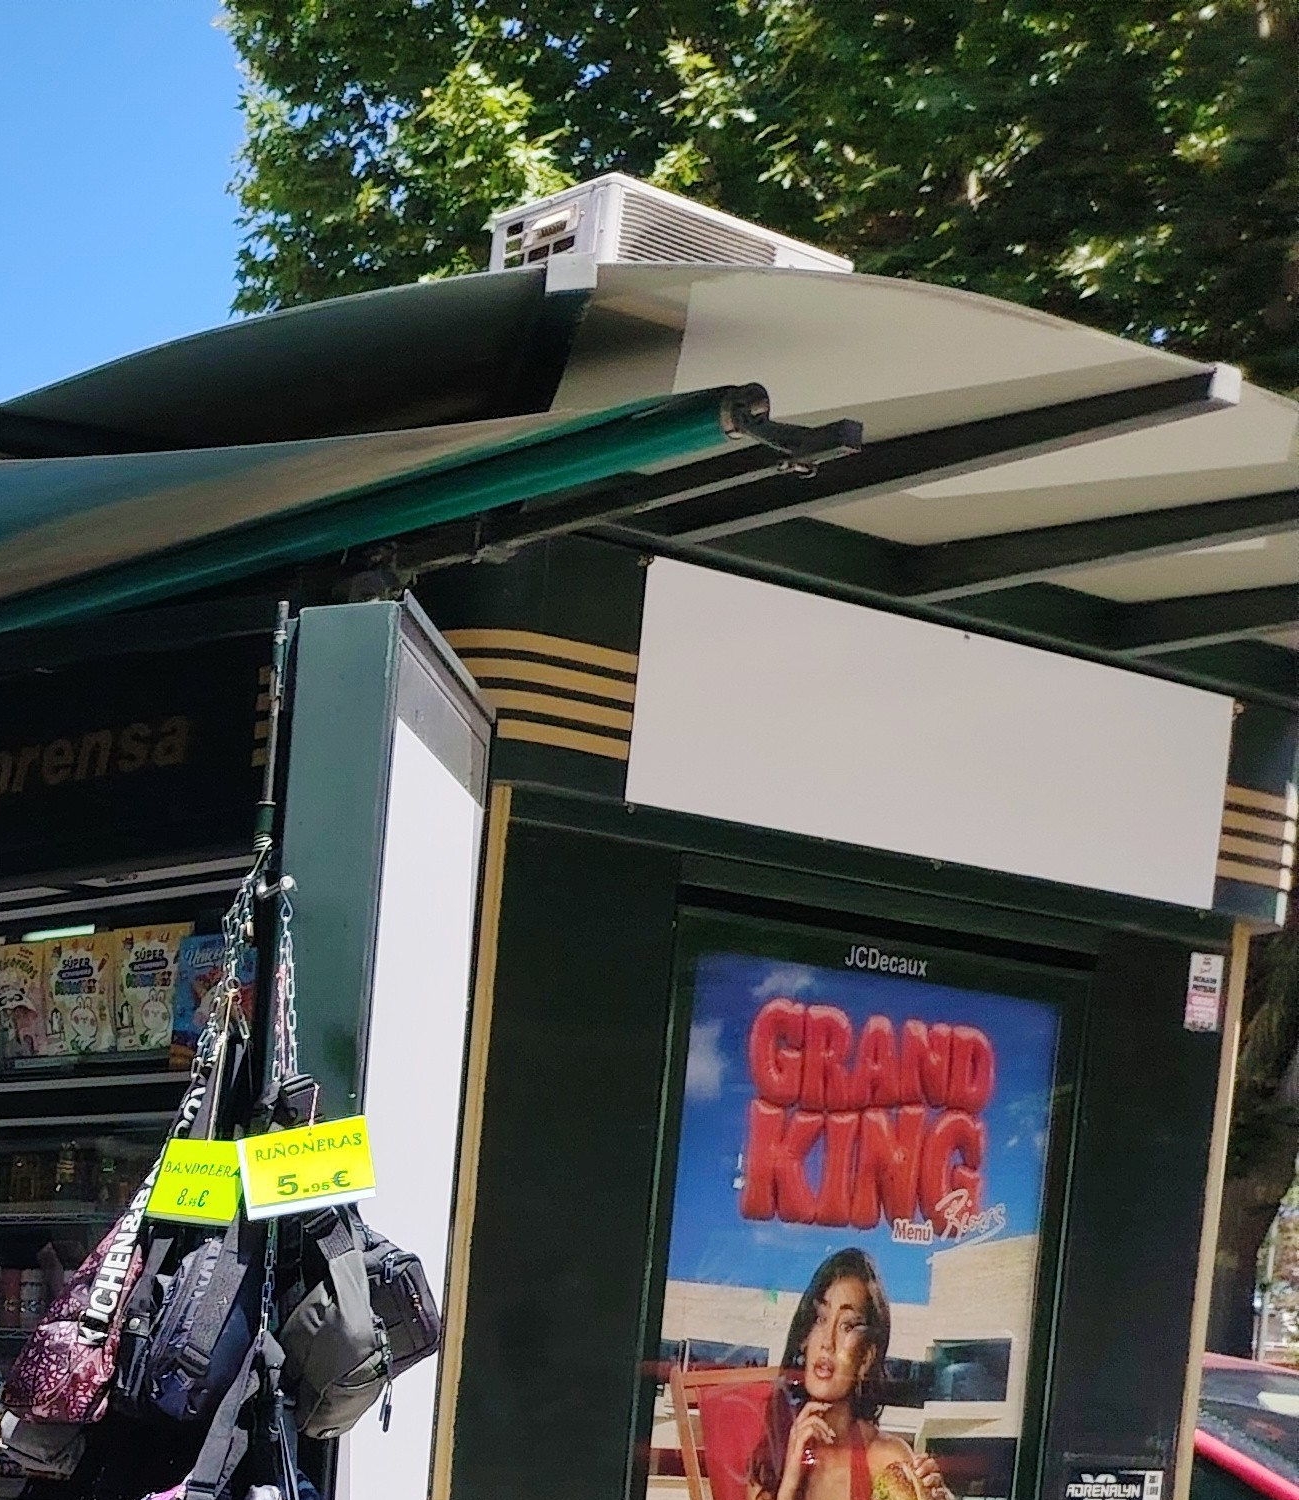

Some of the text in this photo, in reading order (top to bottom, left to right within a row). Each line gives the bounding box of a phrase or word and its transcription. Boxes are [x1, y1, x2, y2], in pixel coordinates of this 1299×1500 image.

[845, 945, 928, 978] JCDecaux
[749, 997, 996, 1111] GRAND
[256, 1132, 362, 1162] RIÑONERAS
[740, 1098, 987, 1238] KING
[892, 1219, 934, 1244] Menú
[1066, 1484, 1141, 1498] ADRENALYN
